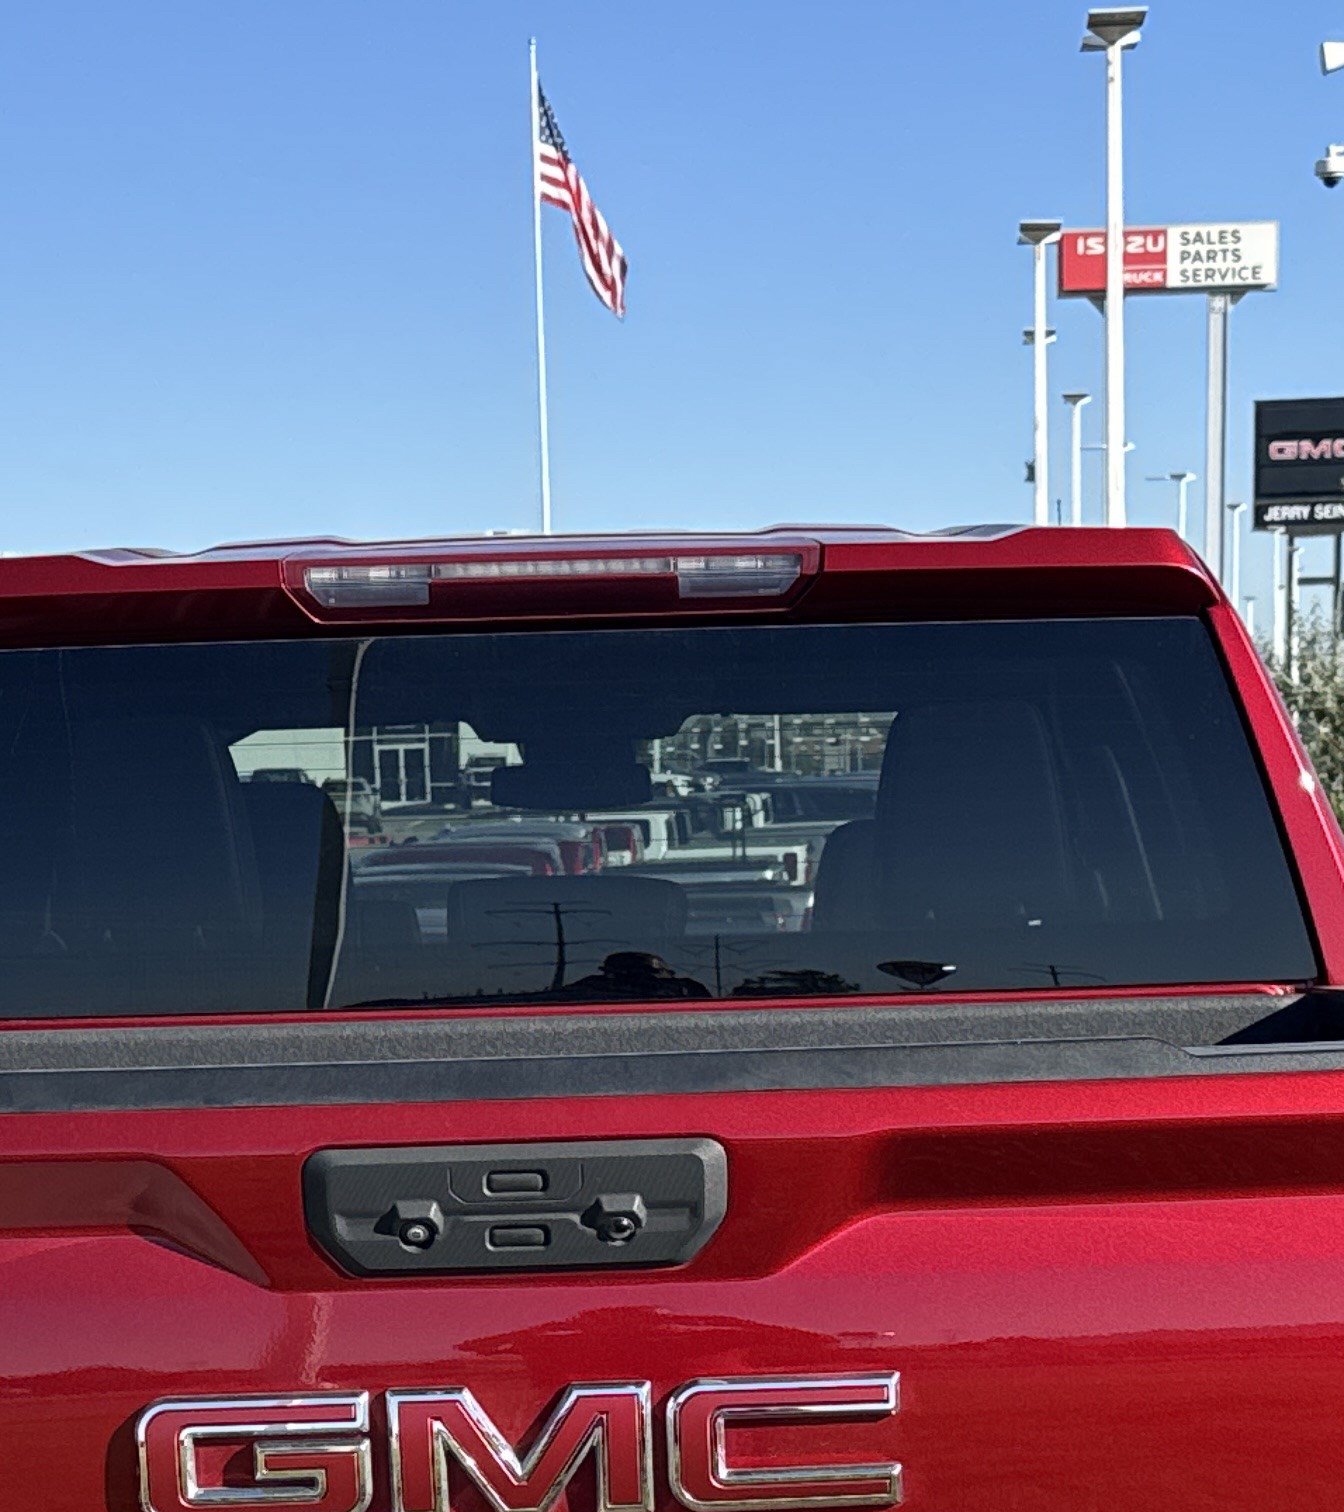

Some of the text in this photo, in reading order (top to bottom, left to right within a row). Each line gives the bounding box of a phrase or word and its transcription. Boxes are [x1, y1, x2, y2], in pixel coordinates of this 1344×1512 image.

[1075, 235, 1164, 255] ISZU
[1179, 229, 1241, 246] SALES
[1180, 248, 1241, 265] PARTS
[1123, 271, 1164, 284] RUCK
[1179, 265, 1263, 282] SERVICE
[1263, 504, 1310, 521] JERRY
